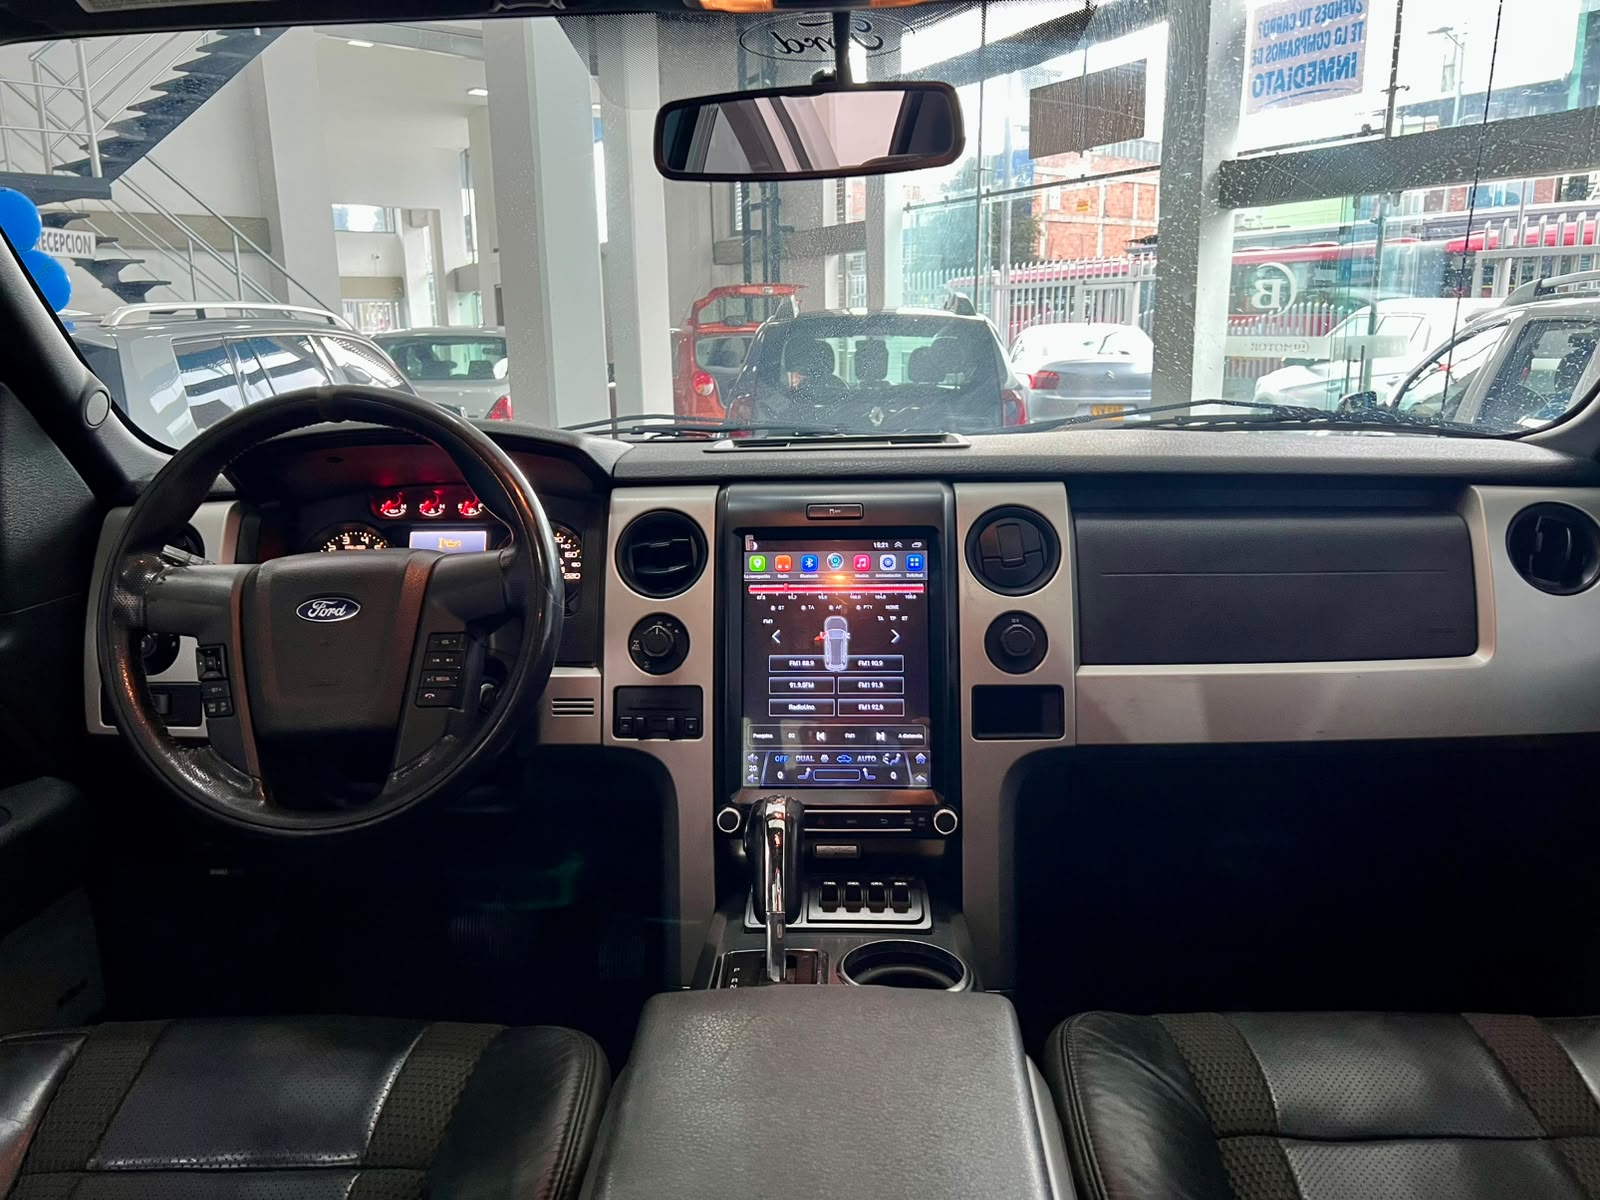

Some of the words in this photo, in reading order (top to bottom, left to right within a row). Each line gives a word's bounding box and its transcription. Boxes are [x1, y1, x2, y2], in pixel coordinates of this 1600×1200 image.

[342, 536, 350, 545] 3
[360, 536, 369, 545] 4
[307, 600, 348, 617] Ford
[775, 755, 790, 763] OFF
